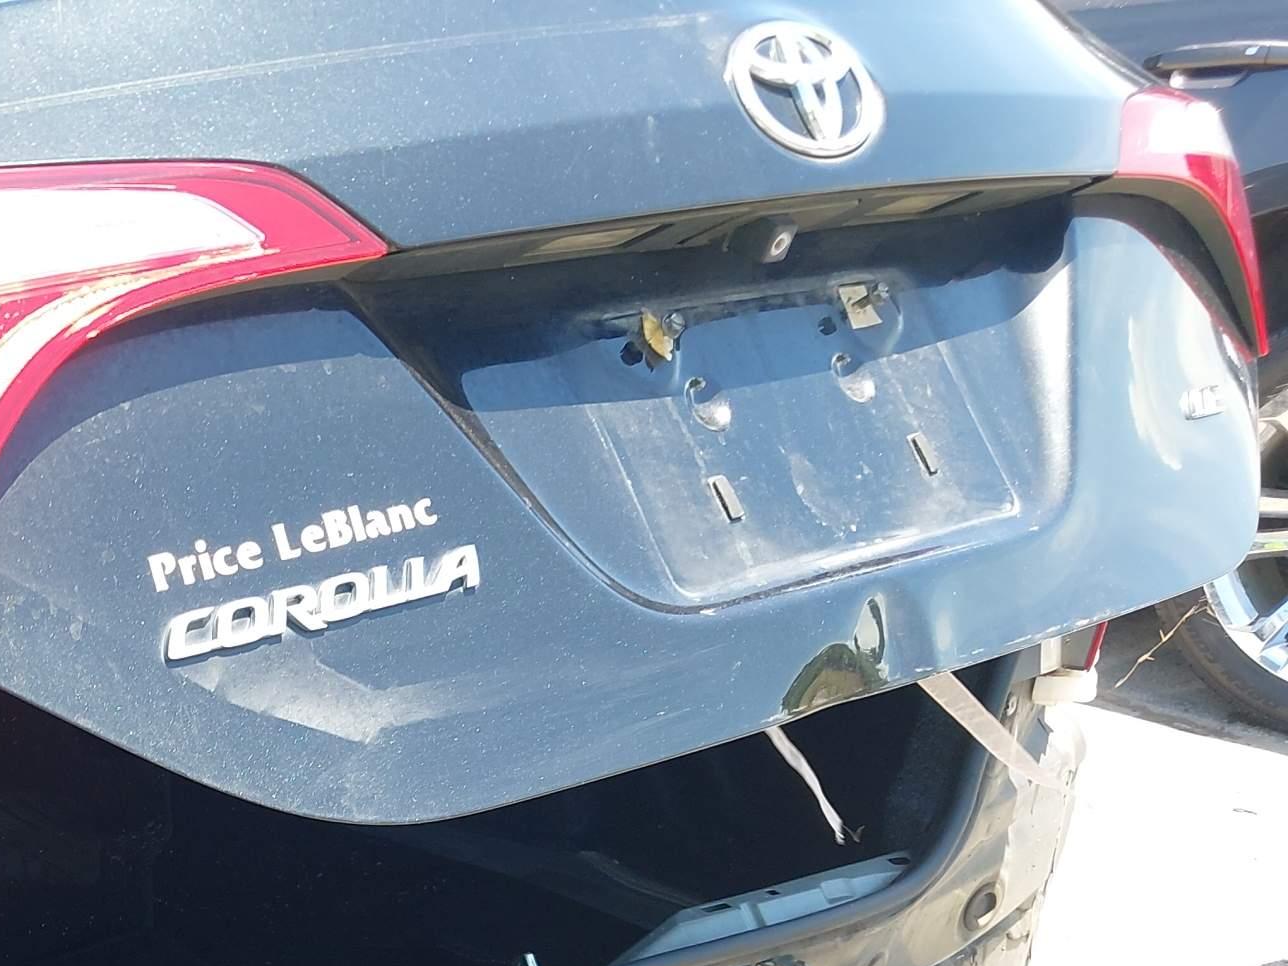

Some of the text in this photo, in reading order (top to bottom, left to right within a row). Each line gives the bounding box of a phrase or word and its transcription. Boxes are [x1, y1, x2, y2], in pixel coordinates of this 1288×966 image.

[147, 498, 438, 592] Price LeBlanc
[162, 543, 480, 663] COROLLA
